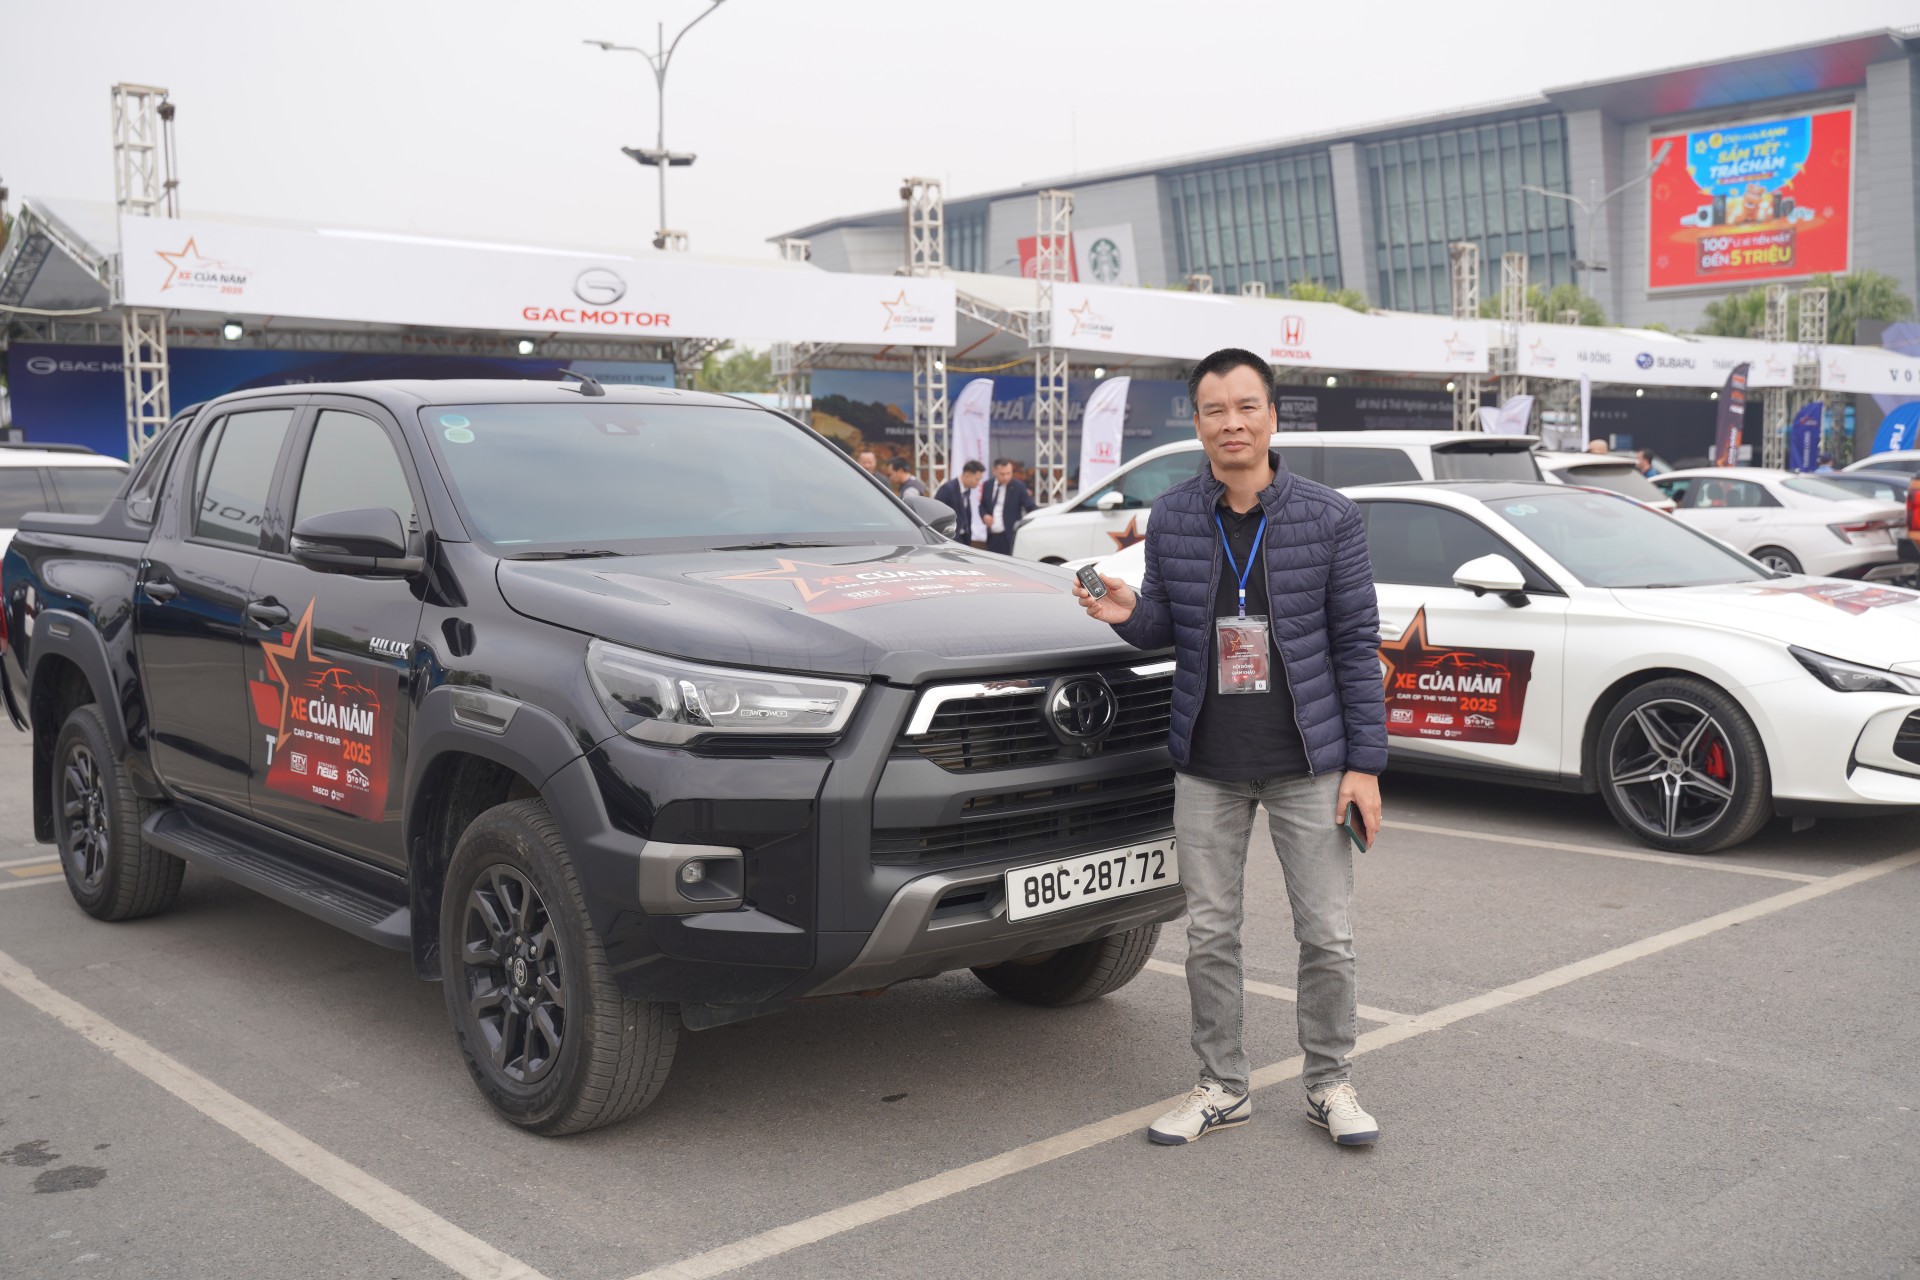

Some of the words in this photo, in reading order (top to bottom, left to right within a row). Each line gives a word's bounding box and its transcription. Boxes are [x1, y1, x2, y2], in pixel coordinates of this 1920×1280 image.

[1731, 249, 1742, 266] 5
[1743, 244, 1791, 265] TRIỆU
[522, 306, 577, 323] GAC
[580, 309, 671, 328] MOTOR
[1270, 348, 1312, 361] HONDA
[1656, 356, 1697, 369] SUBARU
[59, 360, 100, 372] GAC
[1394, 673, 1417, 689] XE
[1418, 670, 1456, 692] CỦA
[1457, 673, 1503, 694] NĂM
[1437, 695, 1457, 703] YEAR
[1459, 697, 1498, 713] 2025
[290, 695, 308, 721] XE
[308, 695, 338, 728] CỦA
[339, 703, 374, 736] NĂM
[293, 727, 305, 738] CAR
[305, 730, 314, 739] OF
[313, 732, 325, 742] THE
[325, 734, 341, 746] YEAR
[1419, 728, 1442, 736] TASCO
[342, 739, 372, 766] 2025
[312, 785, 329, 797] TASCO
